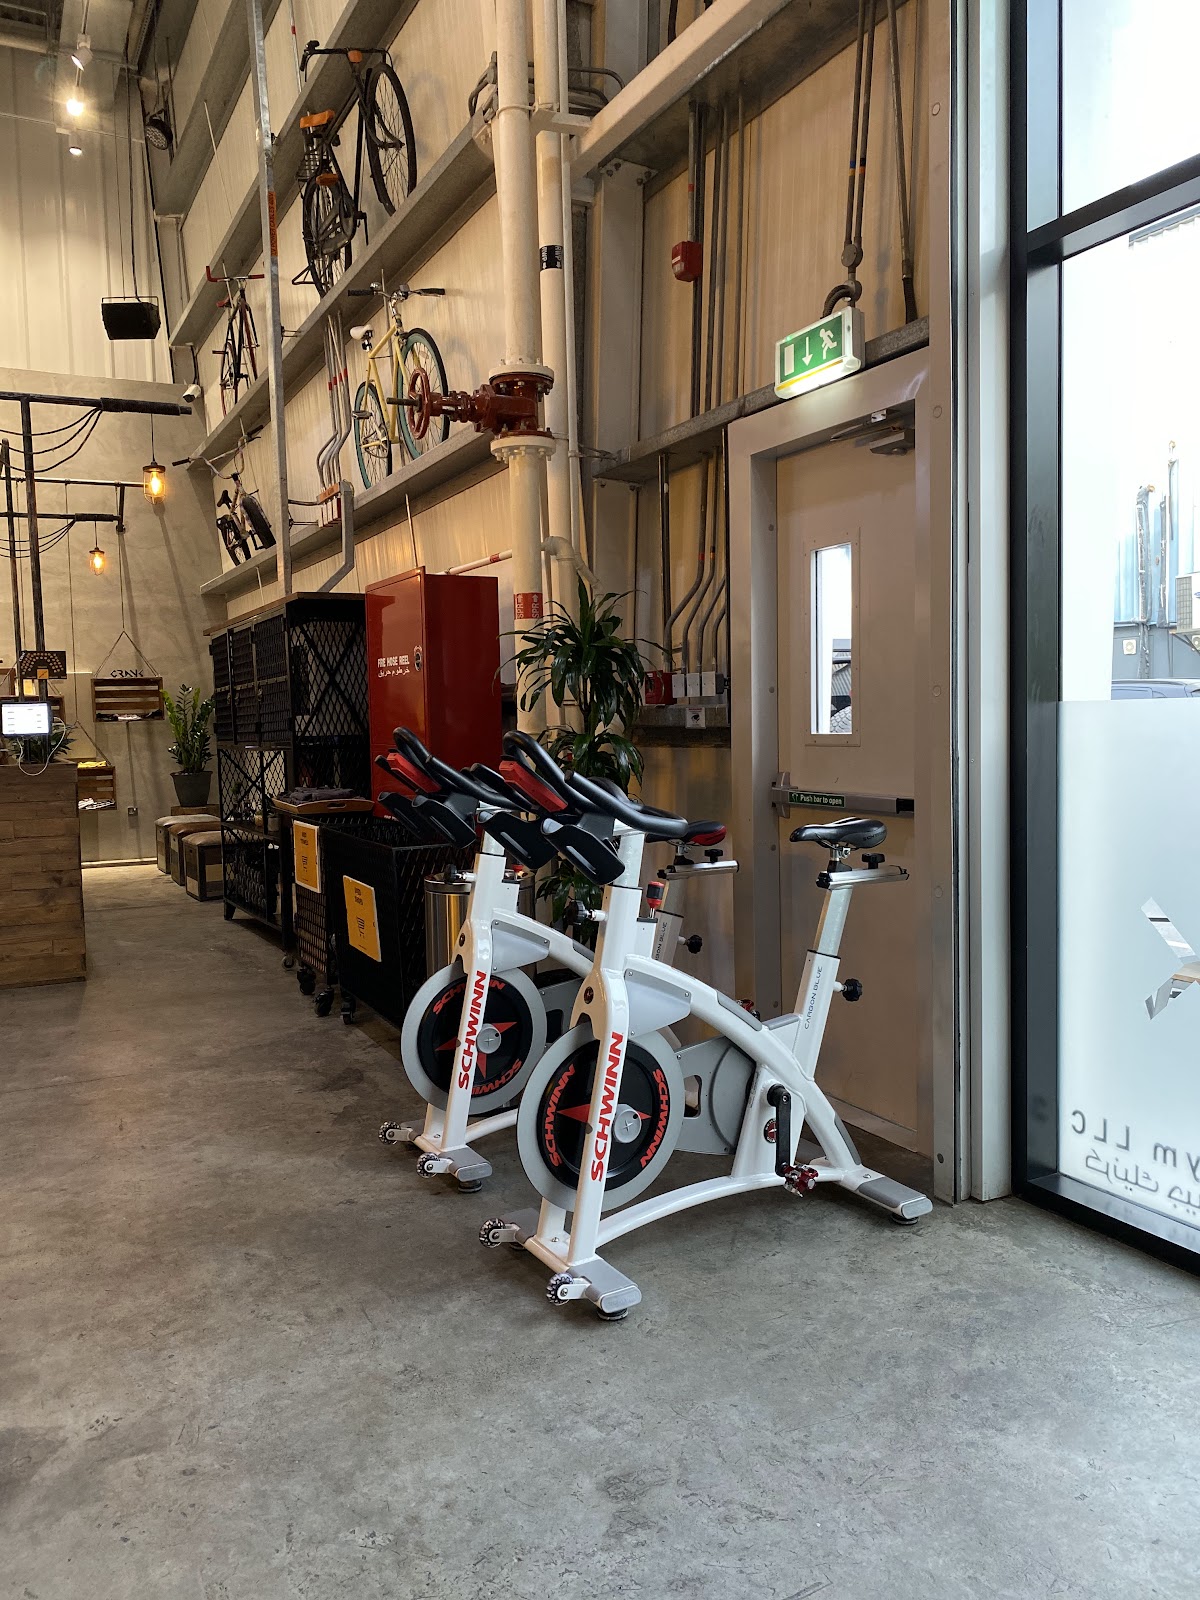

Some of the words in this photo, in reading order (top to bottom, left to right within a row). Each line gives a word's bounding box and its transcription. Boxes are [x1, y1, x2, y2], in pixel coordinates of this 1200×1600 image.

[516, 603, 524, 619] SPR
[531, 602, 540, 618] SPR
[377, 657, 386, 668] FIRE
[387, 655, 399, 667] HOSE
[399, 654, 410, 666] REEL
[800, 794, 813, 803] Push
[813, 795, 822, 803] bar
[822, 796, 829, 804] to
[829, 797, 843, 806] open
[804, 992, 817, 1030] CARBON
[813, 966, 823, 991] BLUE
[458, 970, 487, 1090] SCHWINN
[471, 1058, 523, 1095] SCHWI
[544, 1063, 576, 1167] SCHWINN
[590, 1031, 624, 1182] SCHWINN
[640, 1068, 669, 1168] SCHWINN
